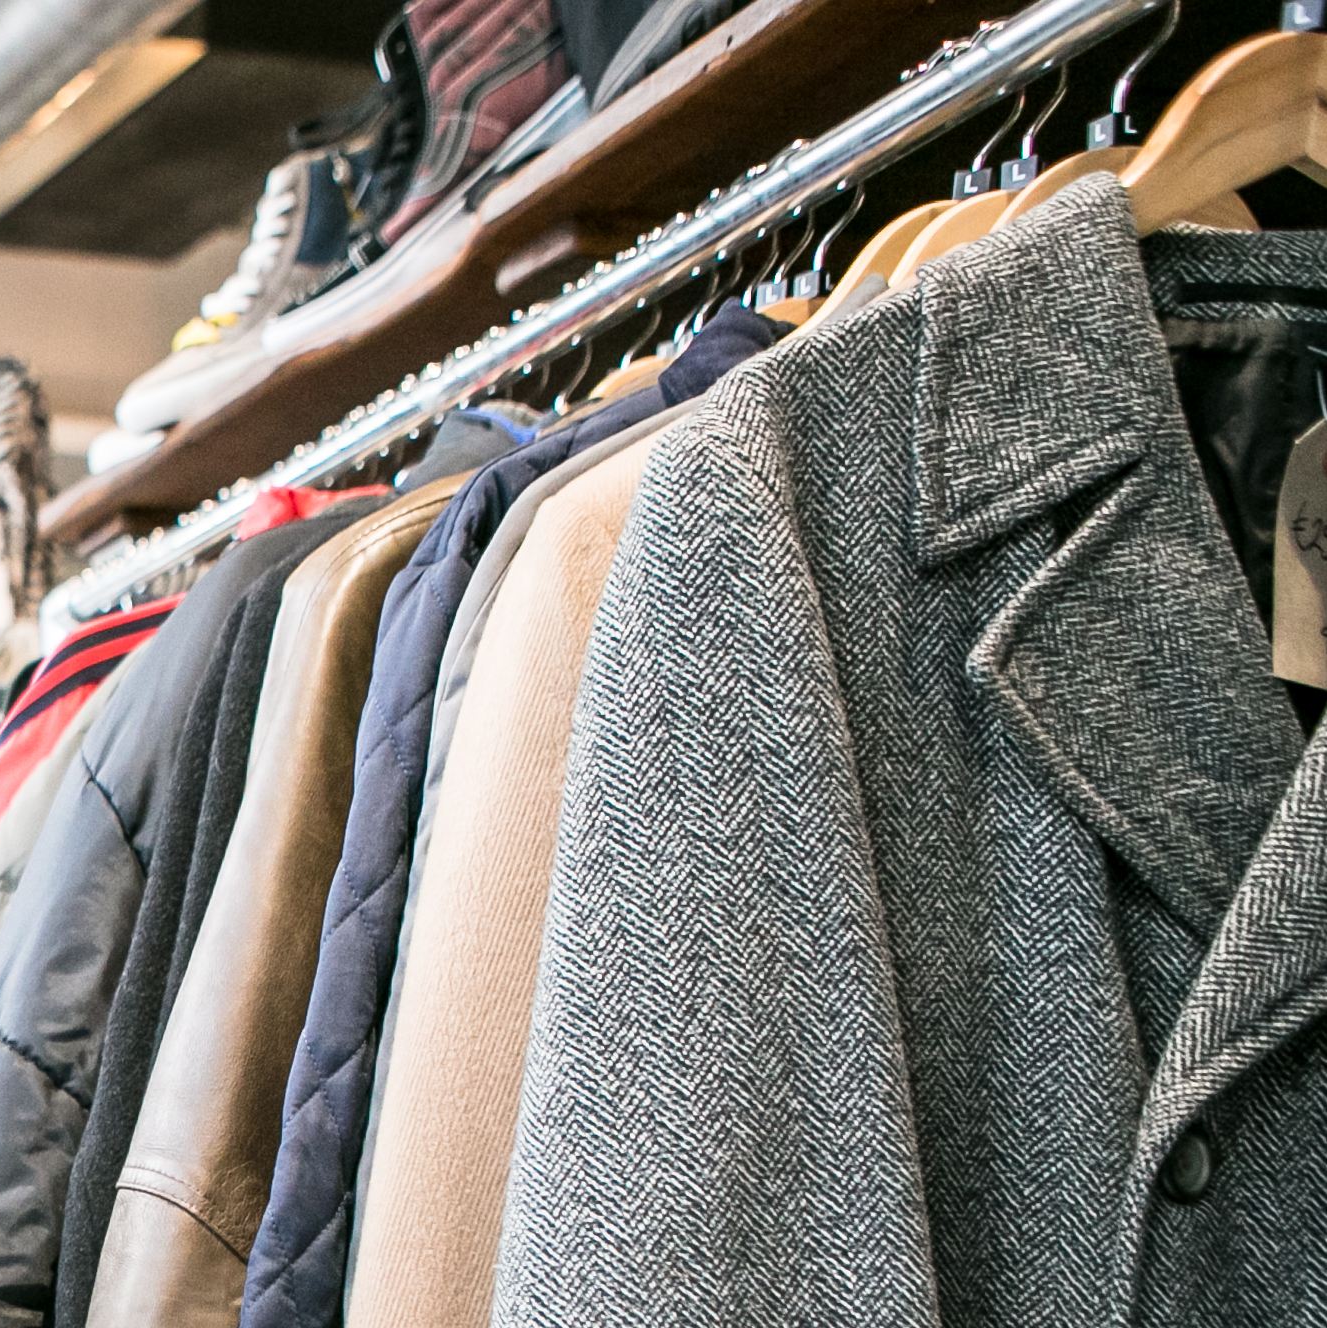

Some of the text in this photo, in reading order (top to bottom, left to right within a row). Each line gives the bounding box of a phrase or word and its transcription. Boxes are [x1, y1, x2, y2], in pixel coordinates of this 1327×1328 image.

[1293, 2, 1312, 25] L
[1094, 123, 1107, 143] L
[1124, 115, 1139, 134] L
[1011, 163, 1027, 182] L
[963, 174, 979, 194] L
[765, 285, 779, 304] L
[799, 276, 812, 296] L
